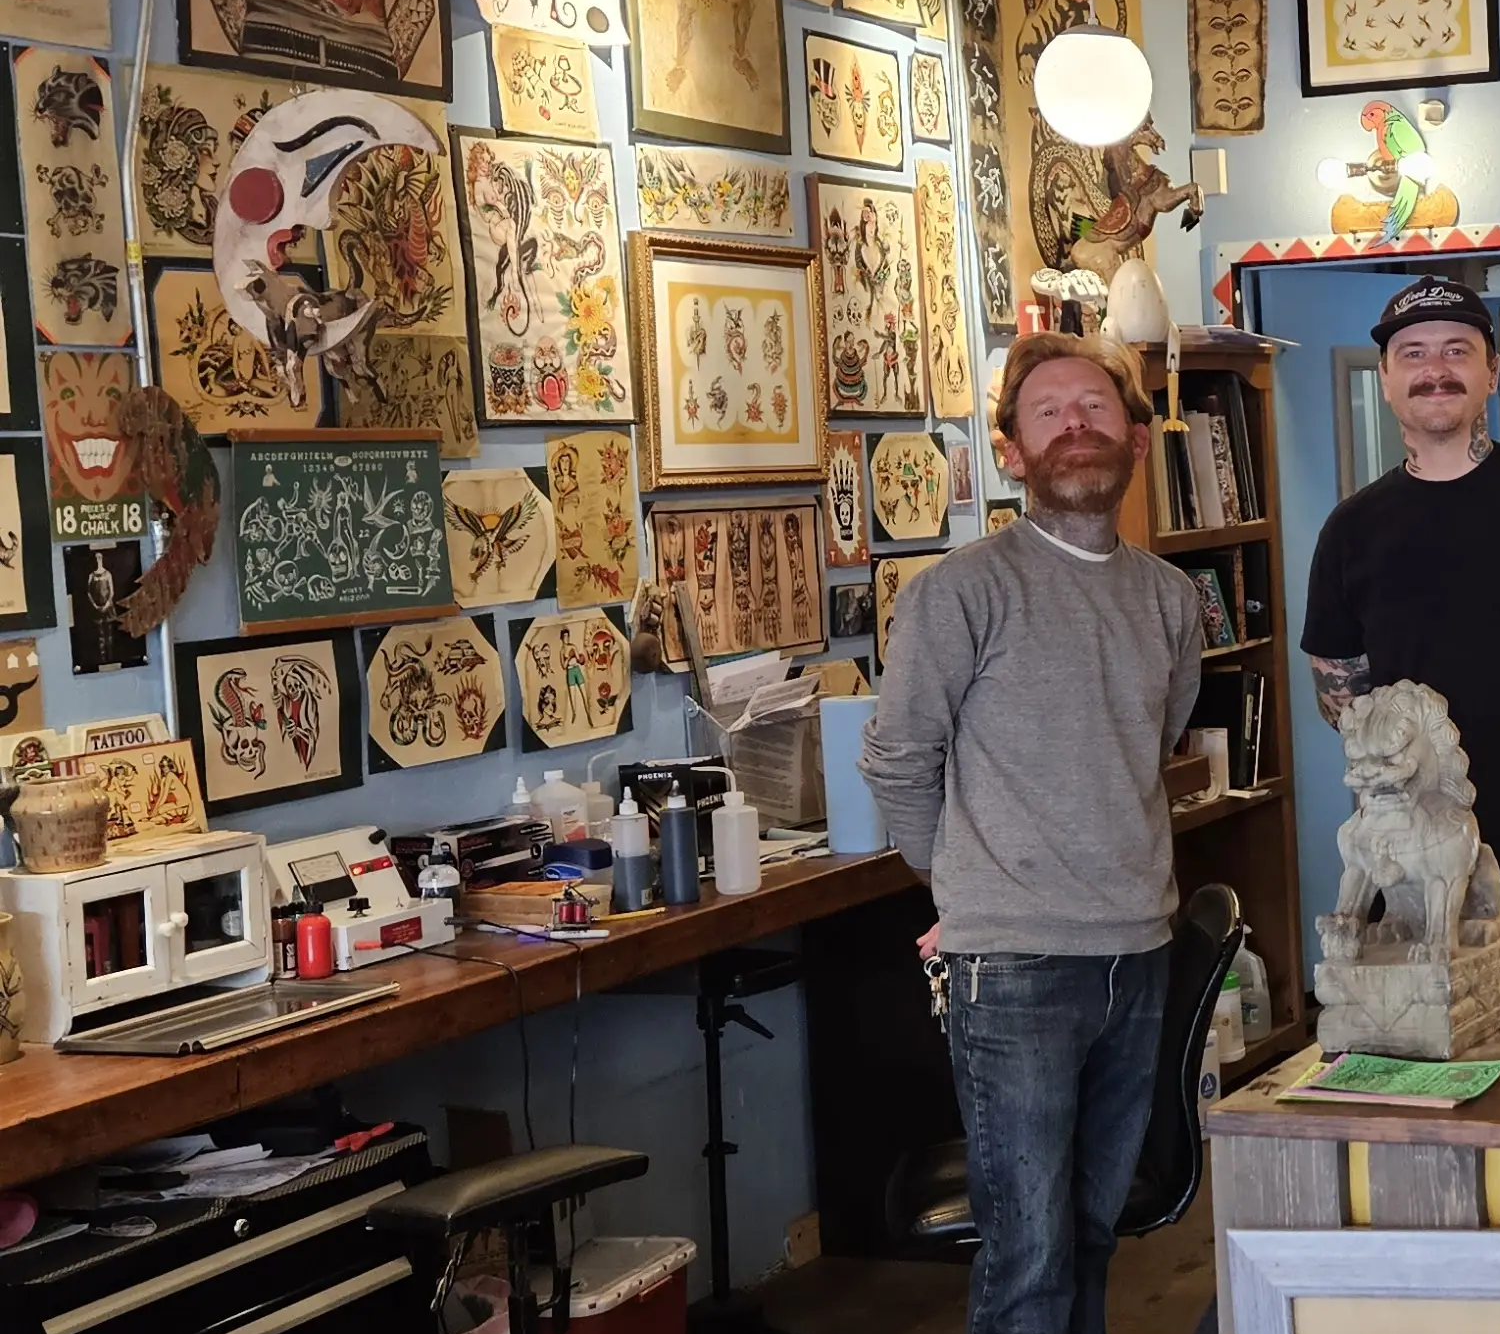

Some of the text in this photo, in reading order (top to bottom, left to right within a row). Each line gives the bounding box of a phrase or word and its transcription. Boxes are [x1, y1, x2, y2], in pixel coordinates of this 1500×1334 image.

[56, 505, 77, 535] 18
[122, 502, 142, 533] 18
[80, 520, 120, 536] CHALK
[90, 728, 145, 751] TATTOO
[637, 771, 673, 781] PHOENIX
[696, 793, 724, 810] PHOENI
